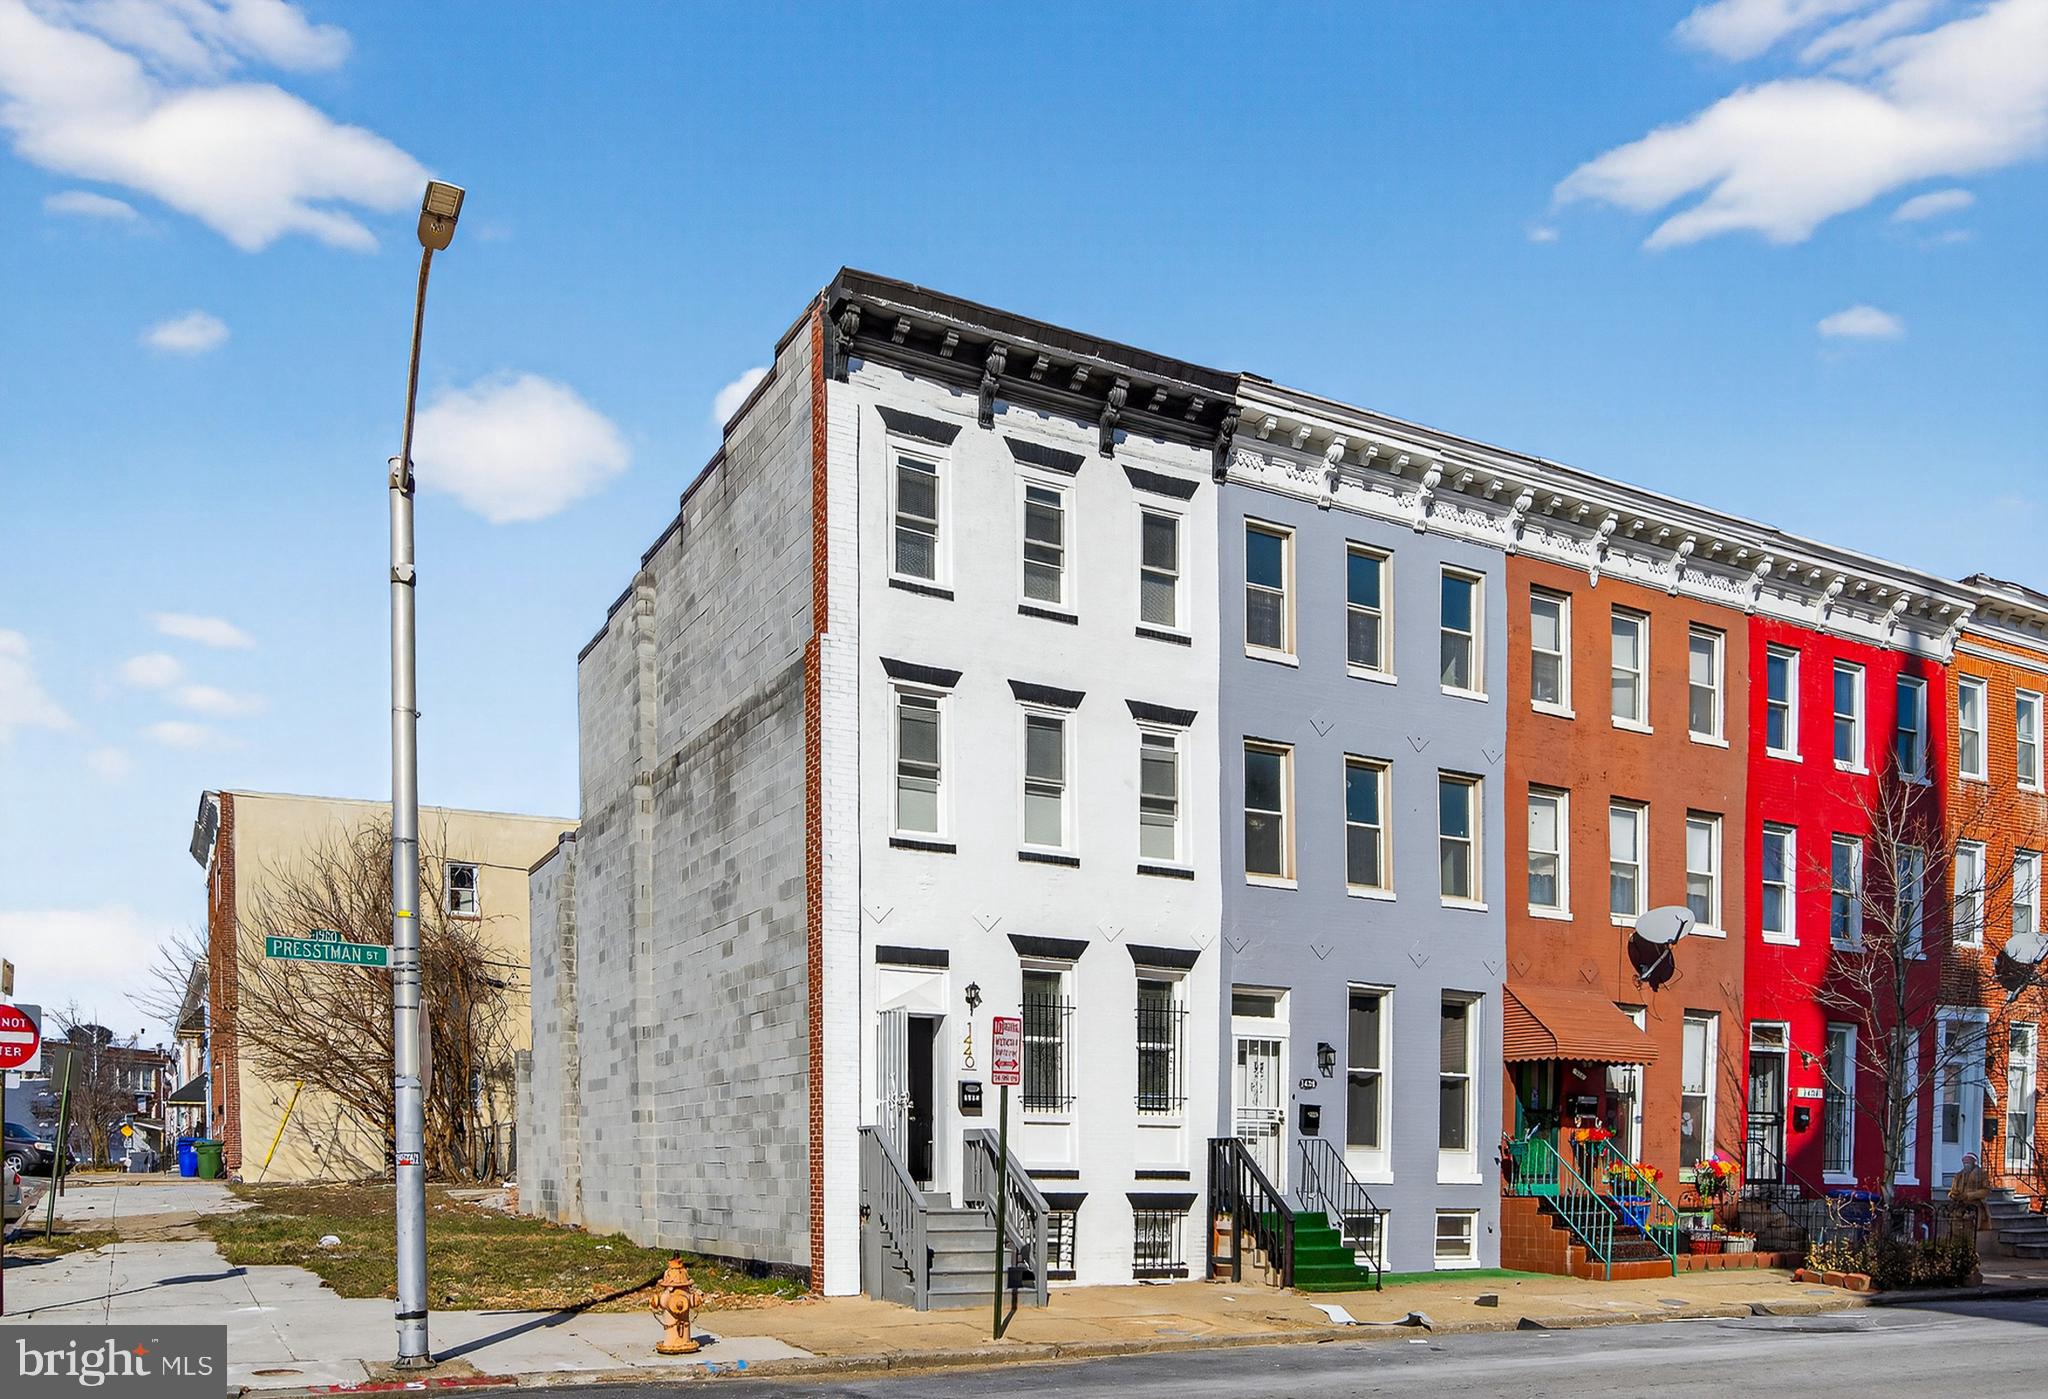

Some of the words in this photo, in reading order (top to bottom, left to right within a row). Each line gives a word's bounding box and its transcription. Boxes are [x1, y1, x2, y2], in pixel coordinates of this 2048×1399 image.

[273, 940, 361, 962] PRESSTMAN
[366, 951, 379, 961] ST
[1, 1017, 26, 1028] NOT
